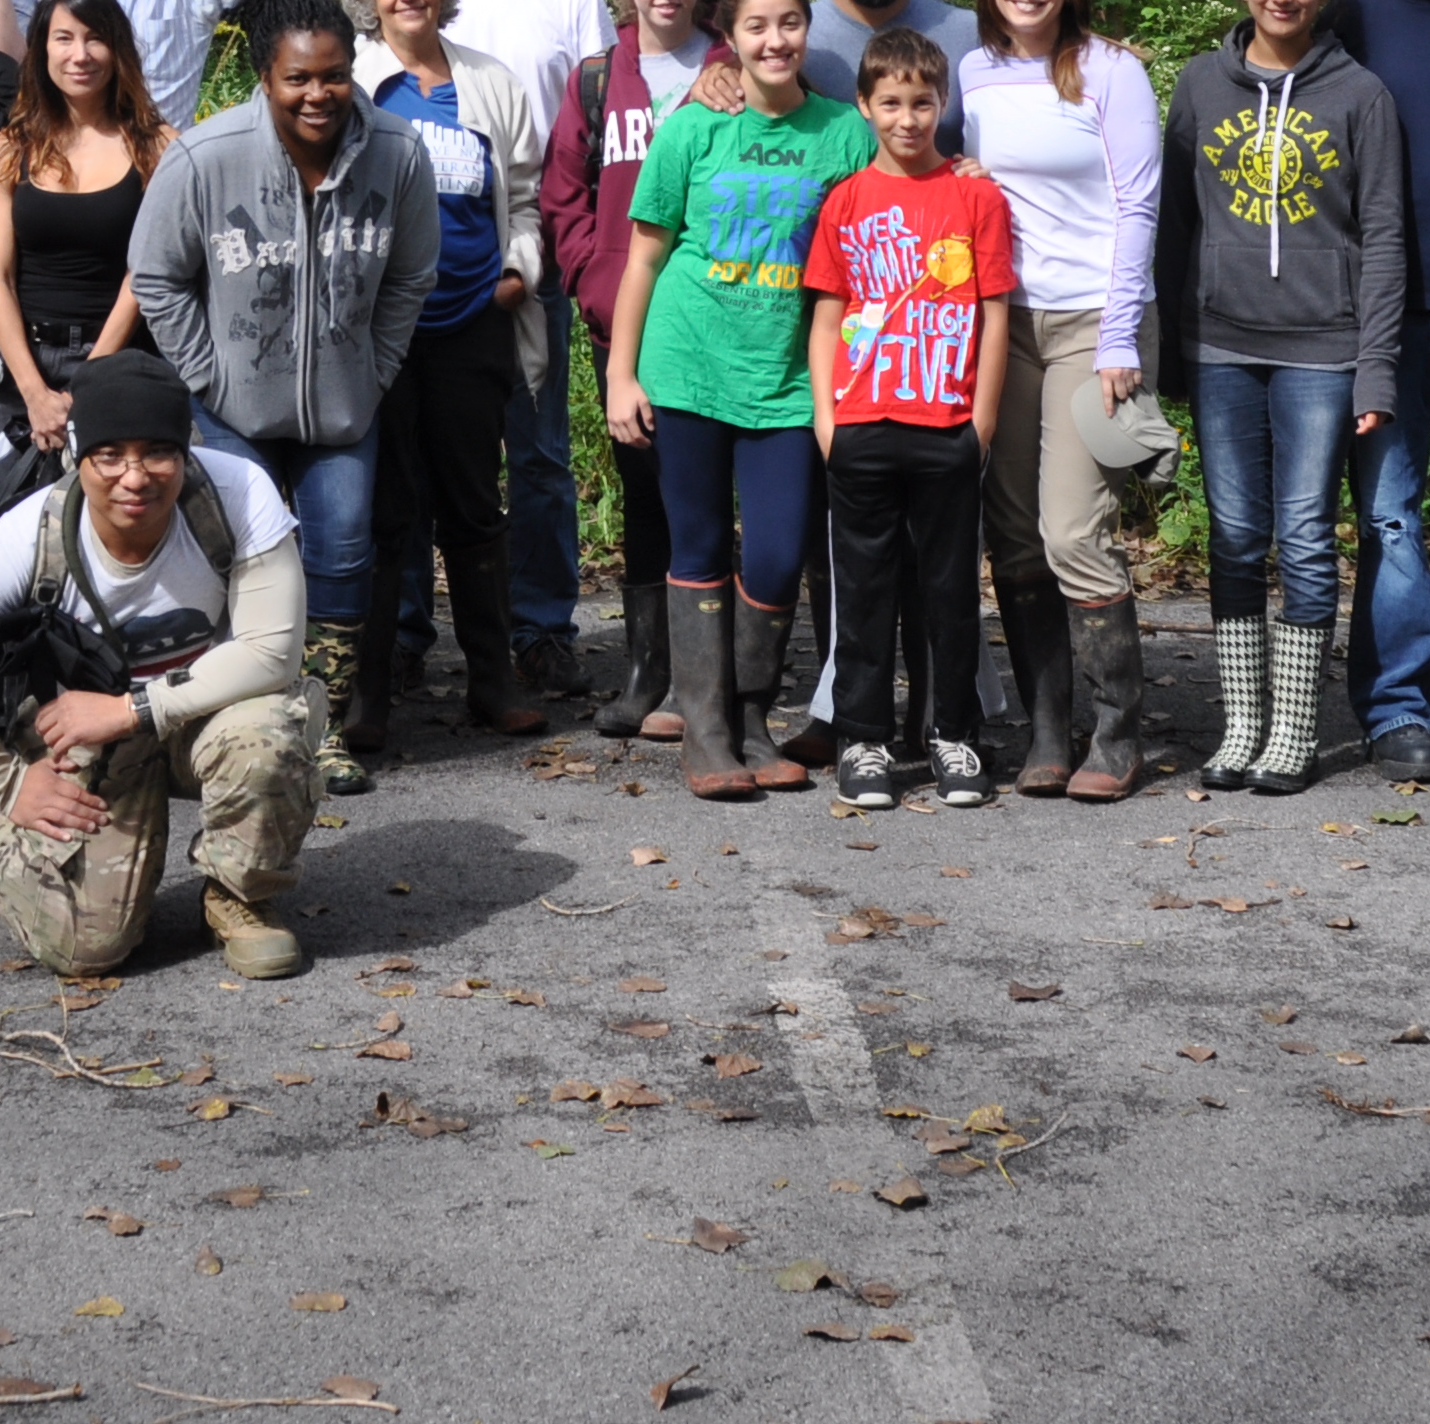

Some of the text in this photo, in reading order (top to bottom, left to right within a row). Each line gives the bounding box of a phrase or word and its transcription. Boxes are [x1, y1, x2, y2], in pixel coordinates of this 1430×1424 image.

[1203, 106, 1340, 172] AMERICAN
[709, 171, 825, 218] STEP
[1219, 169, 1239, 187] NY
[709, 217, 772, 260] UP
[707, 260, 751, 284] FOR
[906, 299, 976, 338] HIGH
[872, 330, 970, 406] FIVE!
